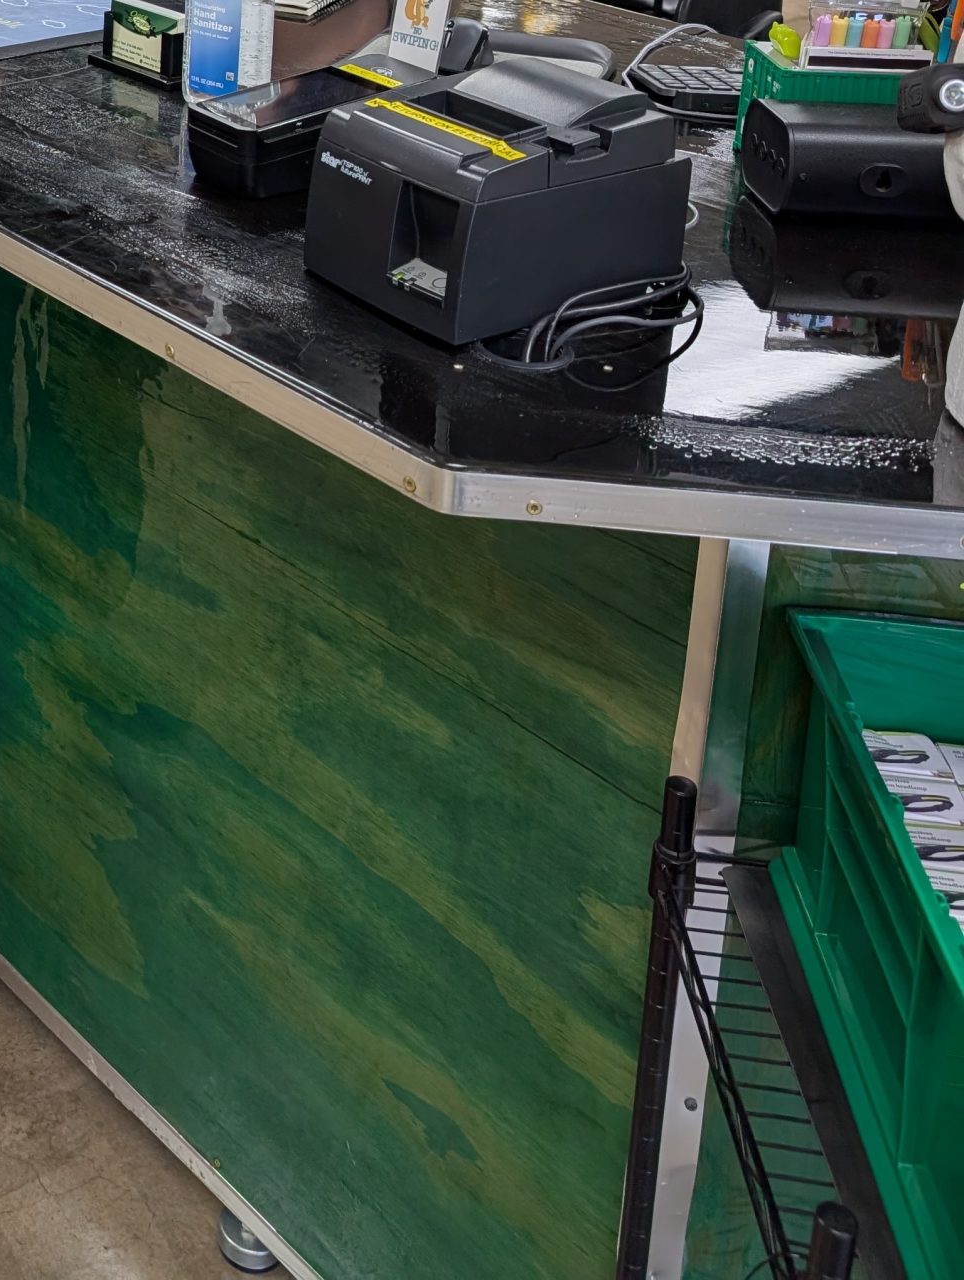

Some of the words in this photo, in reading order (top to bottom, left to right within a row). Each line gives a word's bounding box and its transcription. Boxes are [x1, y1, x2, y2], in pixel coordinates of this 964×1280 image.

[194, 8, 217, 20] Hand
[193, 17, 233, 33] Sanitizer
[412, 27, 423, 35] NO
[392, 31, 440, 52] SWIPING!
[453, 127, 518, 158] ELECTRICAL
